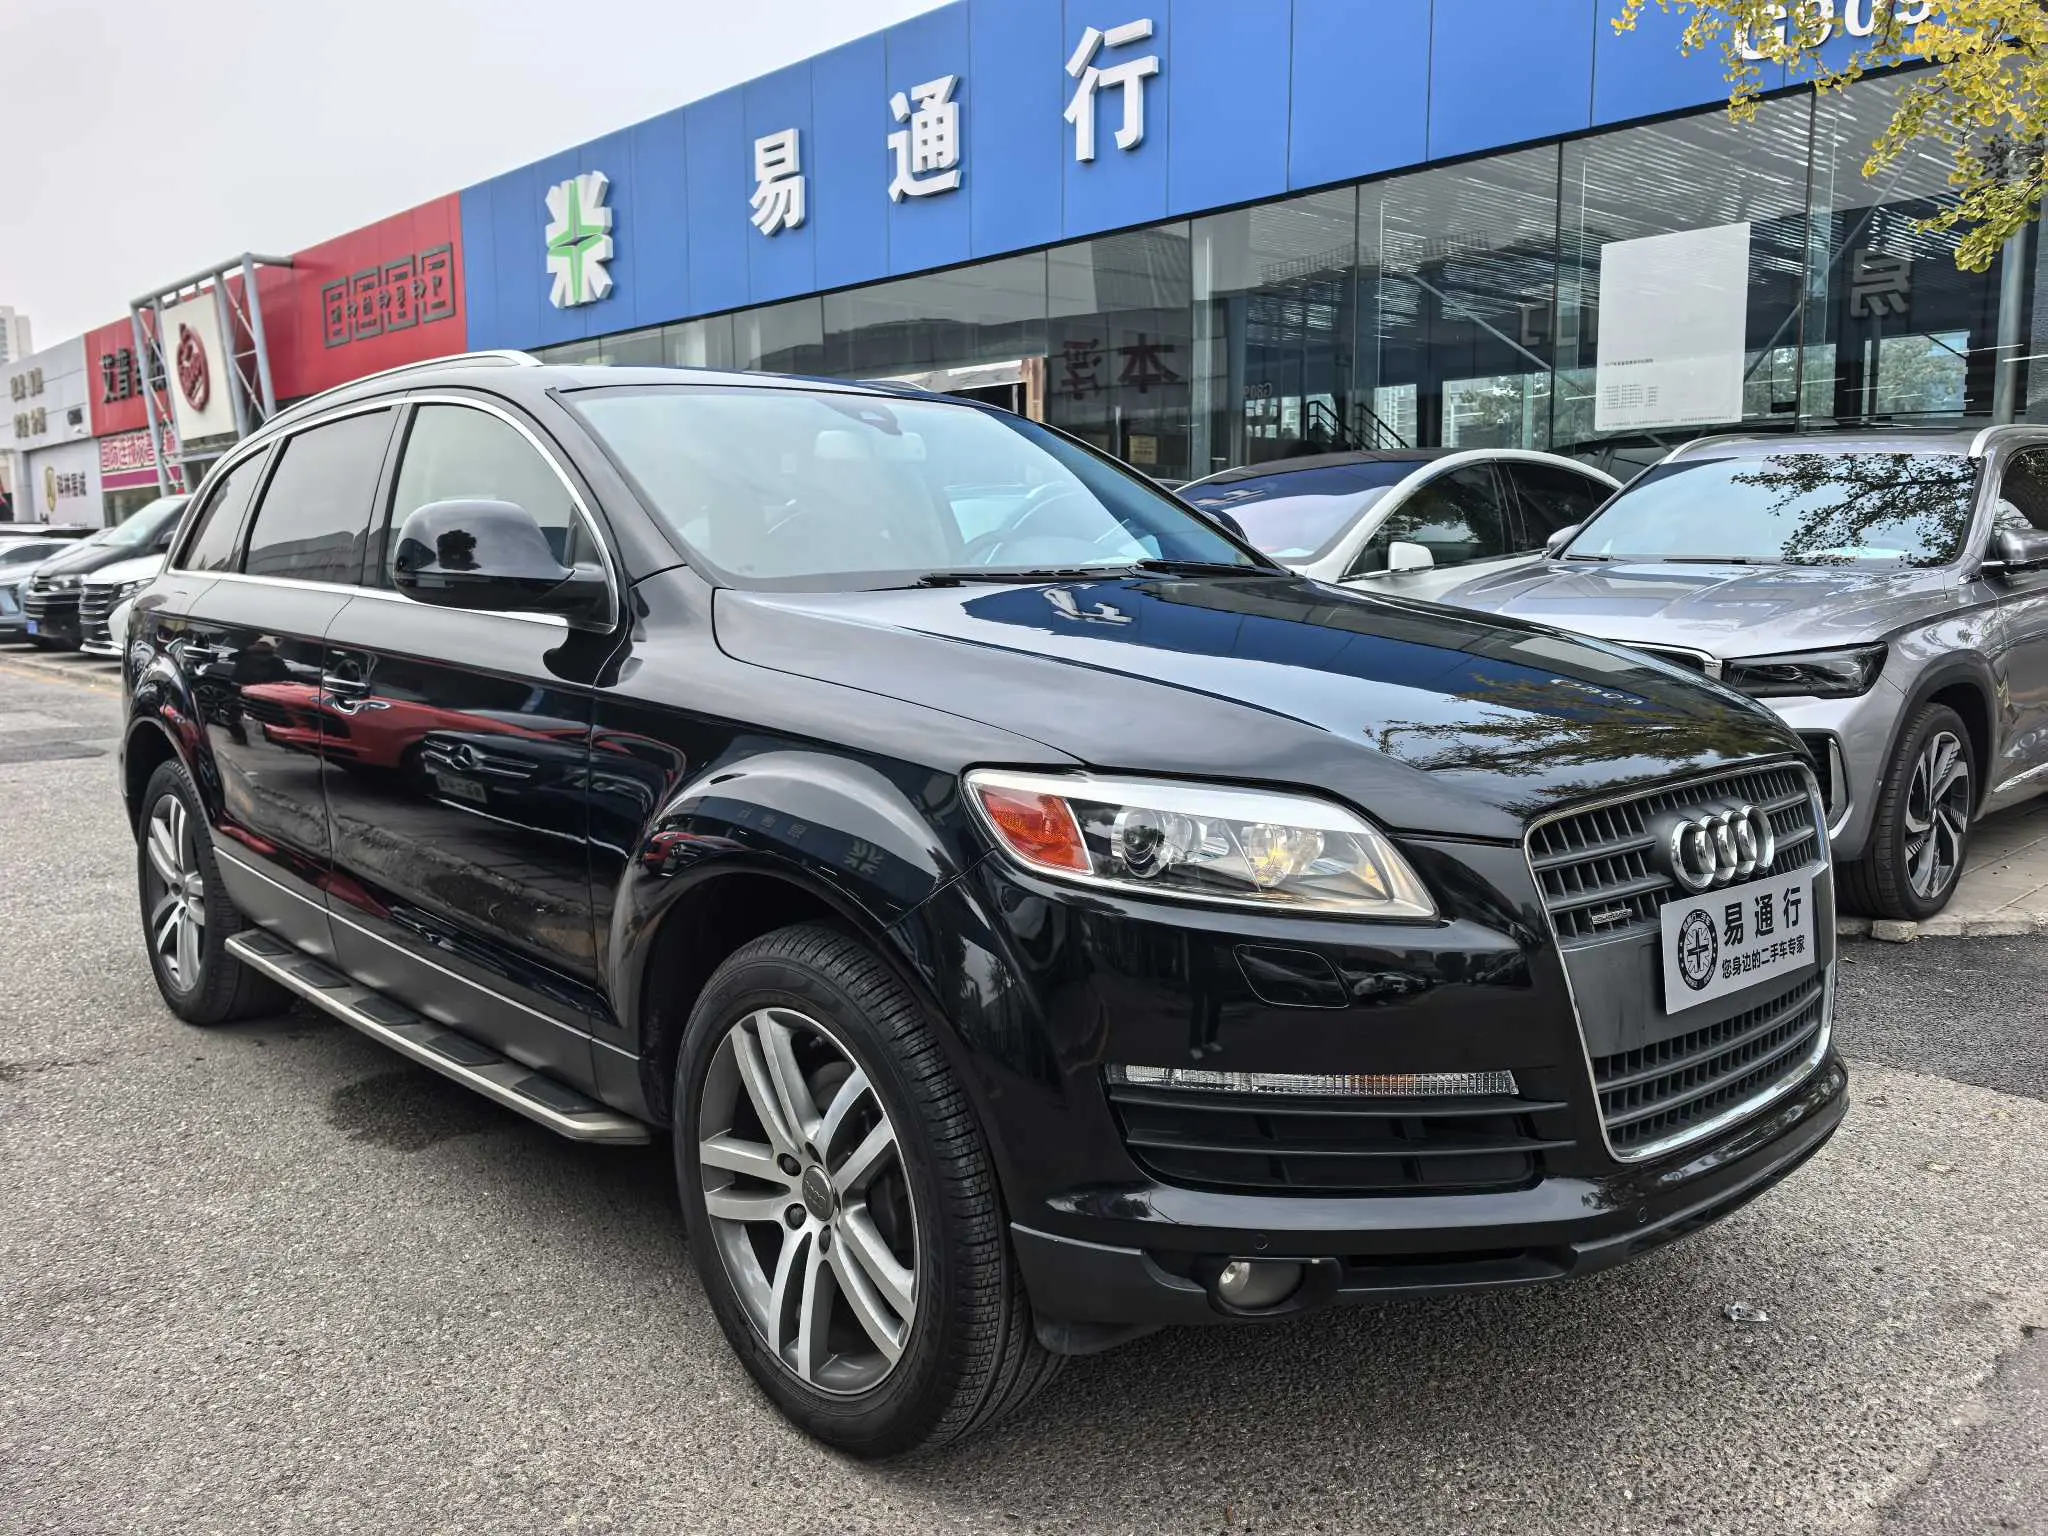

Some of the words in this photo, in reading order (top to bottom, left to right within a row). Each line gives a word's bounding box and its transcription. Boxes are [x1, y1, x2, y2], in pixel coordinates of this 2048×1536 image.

[748, 17, 1160, 238] 易通行
[1723, 886, 1802, 947] 易通行
[1721, 934, 1805, 980] 您身边的二手车专家
